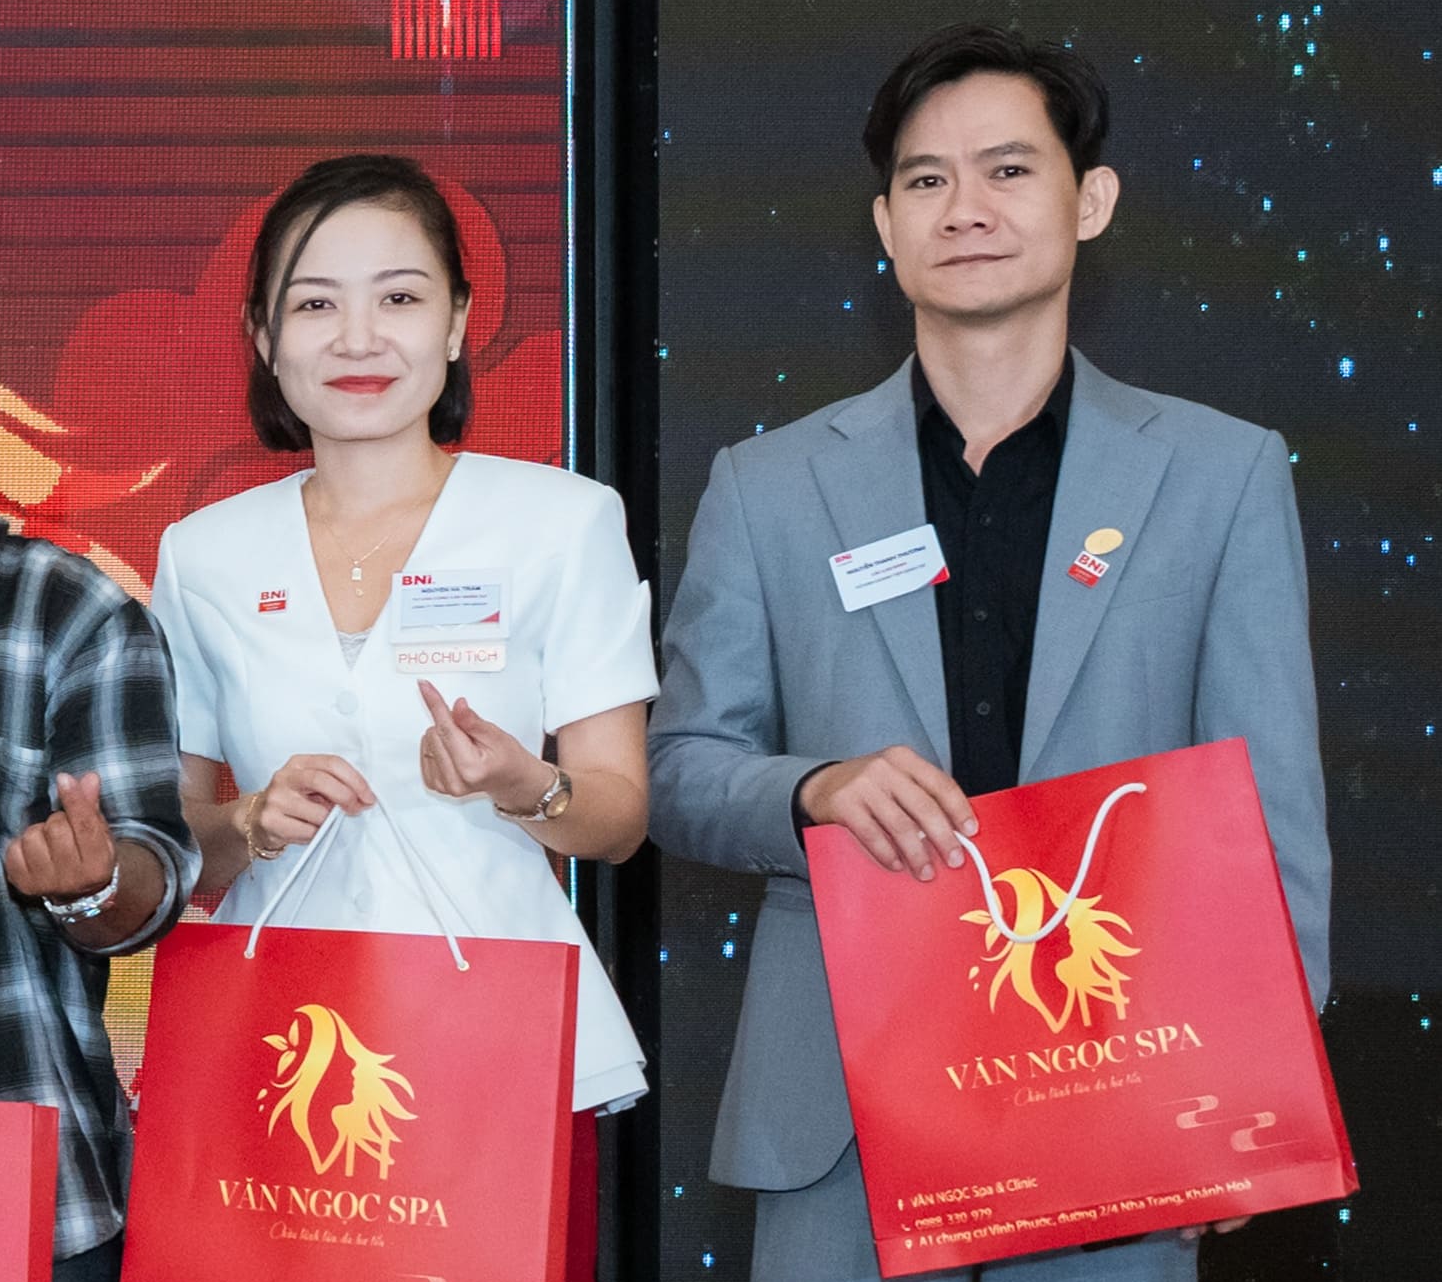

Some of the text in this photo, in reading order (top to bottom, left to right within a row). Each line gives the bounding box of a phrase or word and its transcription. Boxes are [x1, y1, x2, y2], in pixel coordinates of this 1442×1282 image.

[1078, 554, 1105, 574] BNI
[402, 575, 432, 585] BNI
[260, 589, 285, 600] BNI
[945, 1054, 1017, 1090] VĂN
[1026, 1034, 1126, 1077] NGỌC
[1134, 1022, 1202, 1057] SPA
[971, 1184, 994, 1197] Spa
[995, 1181, 1005, 1193] &
[1005, 1176, 1038, 1192] Clinic
[218, 1177, 447, 1227] VĂN NGỌC SPA
[919, 1234, 933, 1246] A1
[935, 1230, 972, 1245] chung
[1099, 1203, 1119, 1216] 2/4
[1119, 1200, 1145, 1211] Nha
